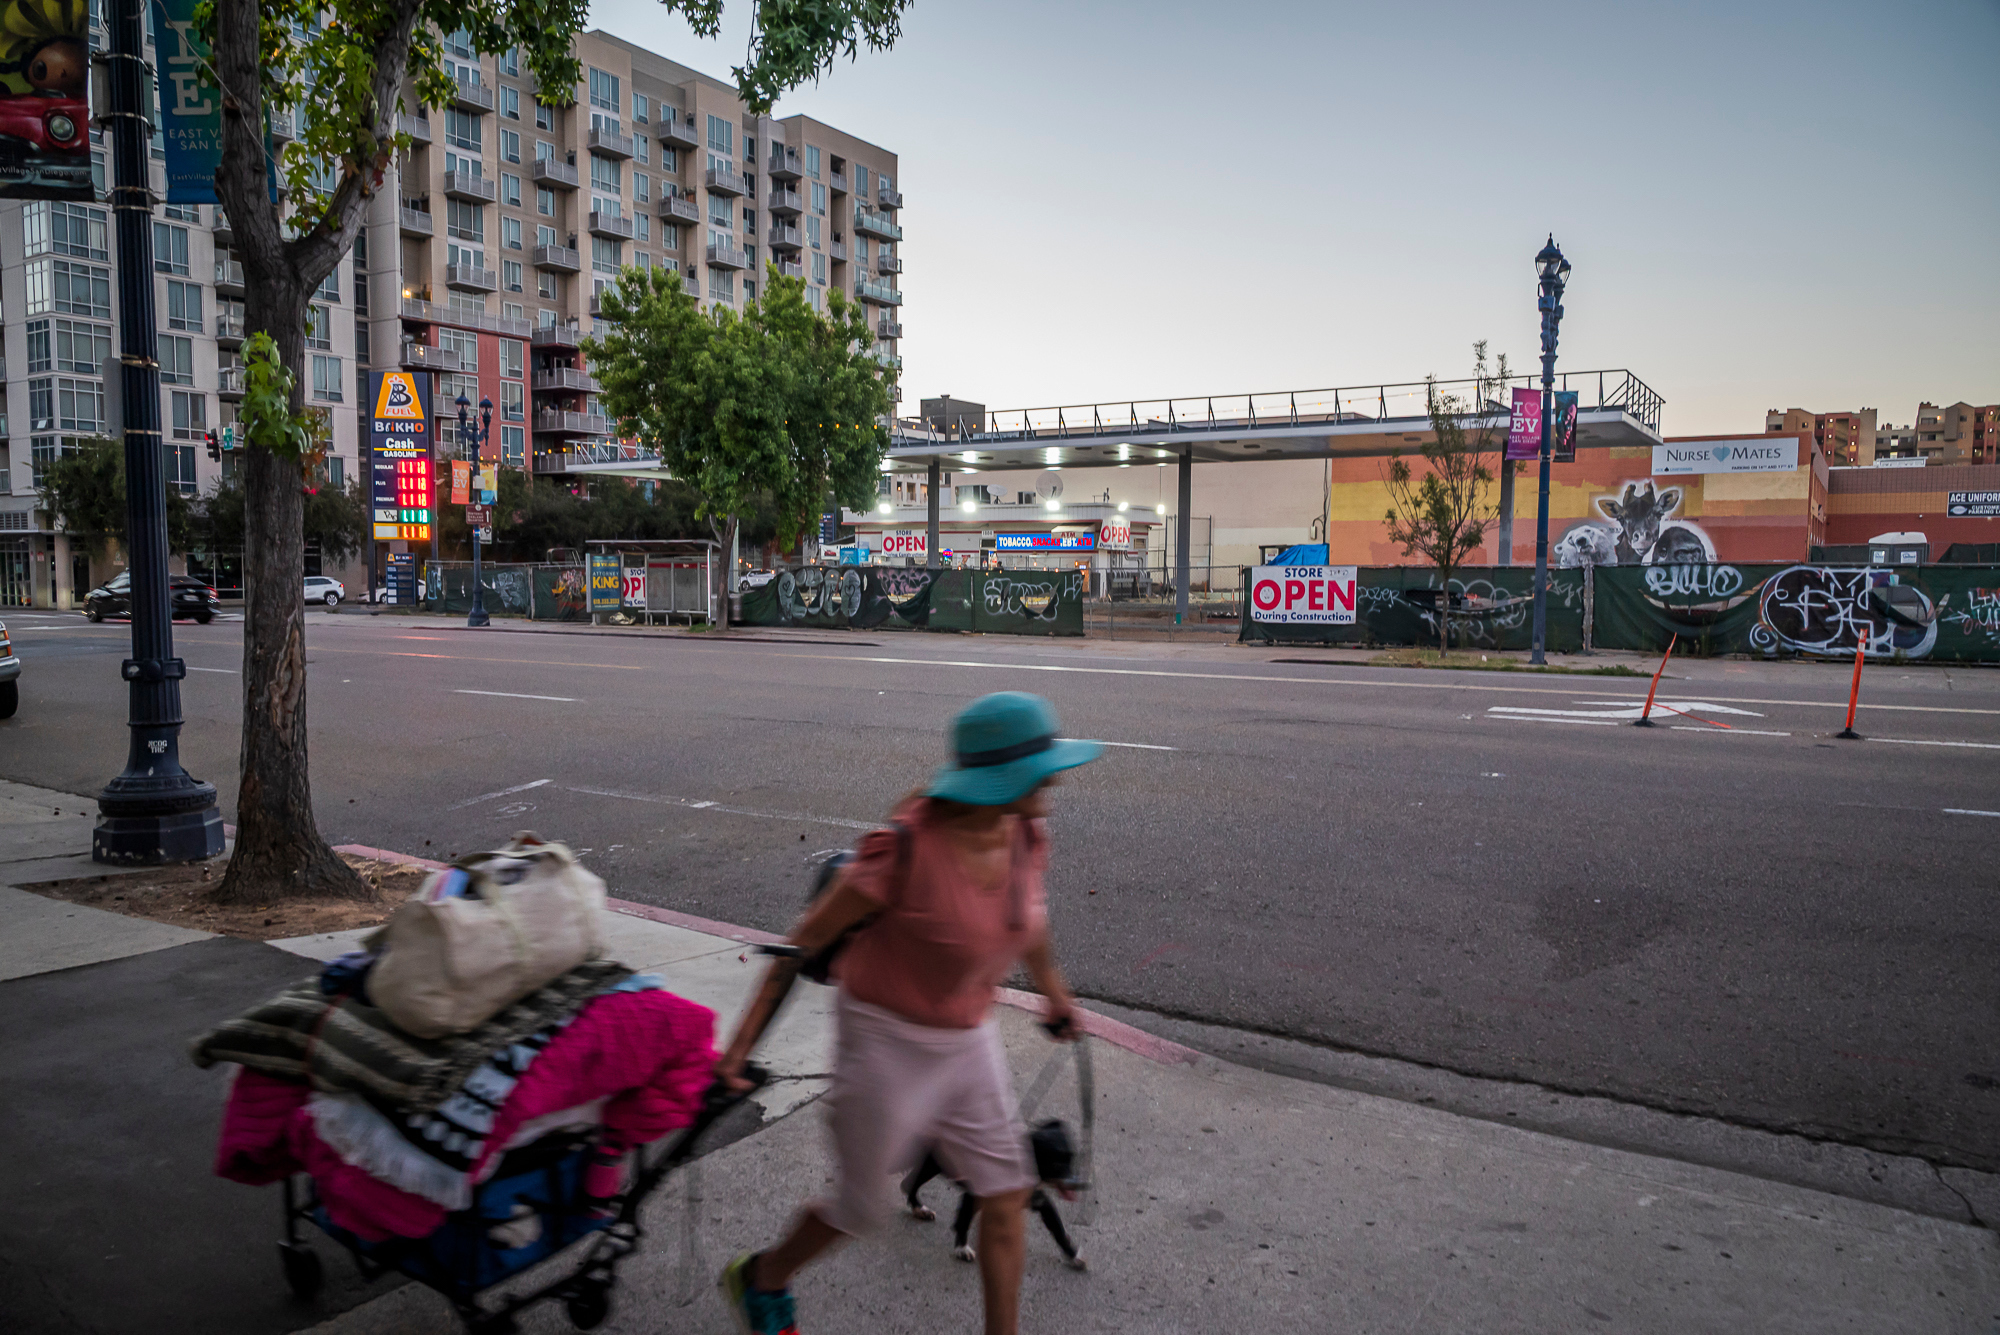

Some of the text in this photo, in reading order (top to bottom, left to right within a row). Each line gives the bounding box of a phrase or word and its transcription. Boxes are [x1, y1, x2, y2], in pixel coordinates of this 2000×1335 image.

[169, 128, 203, 139] EAST
[180, 140, 208, 151] SAN
[385, 408, 415, 417] FUEL
[1513, 401, 1523, 417] I
[1511, 417, 1539, 433] EV
[385, 437, 415, 449] Cash
[383, 450, 418, 458] GASOLINE
[1666, 447, 1782, 462] NURSE MATES
[453, 468, 459, 478] I
[453, 478, 467, 489] EV
[1950, 493, 1966, 502] ACE
[1101, 525, 1130, 543] OPEN
[883, 536, 925, 552] OPEN
[1285, 568, 1323, 577] STORE
[592, 576, 619, 589] KING
[1253, 579, 1355, 611] OPEN
[1255, 611, 1352, 622] During Construction
